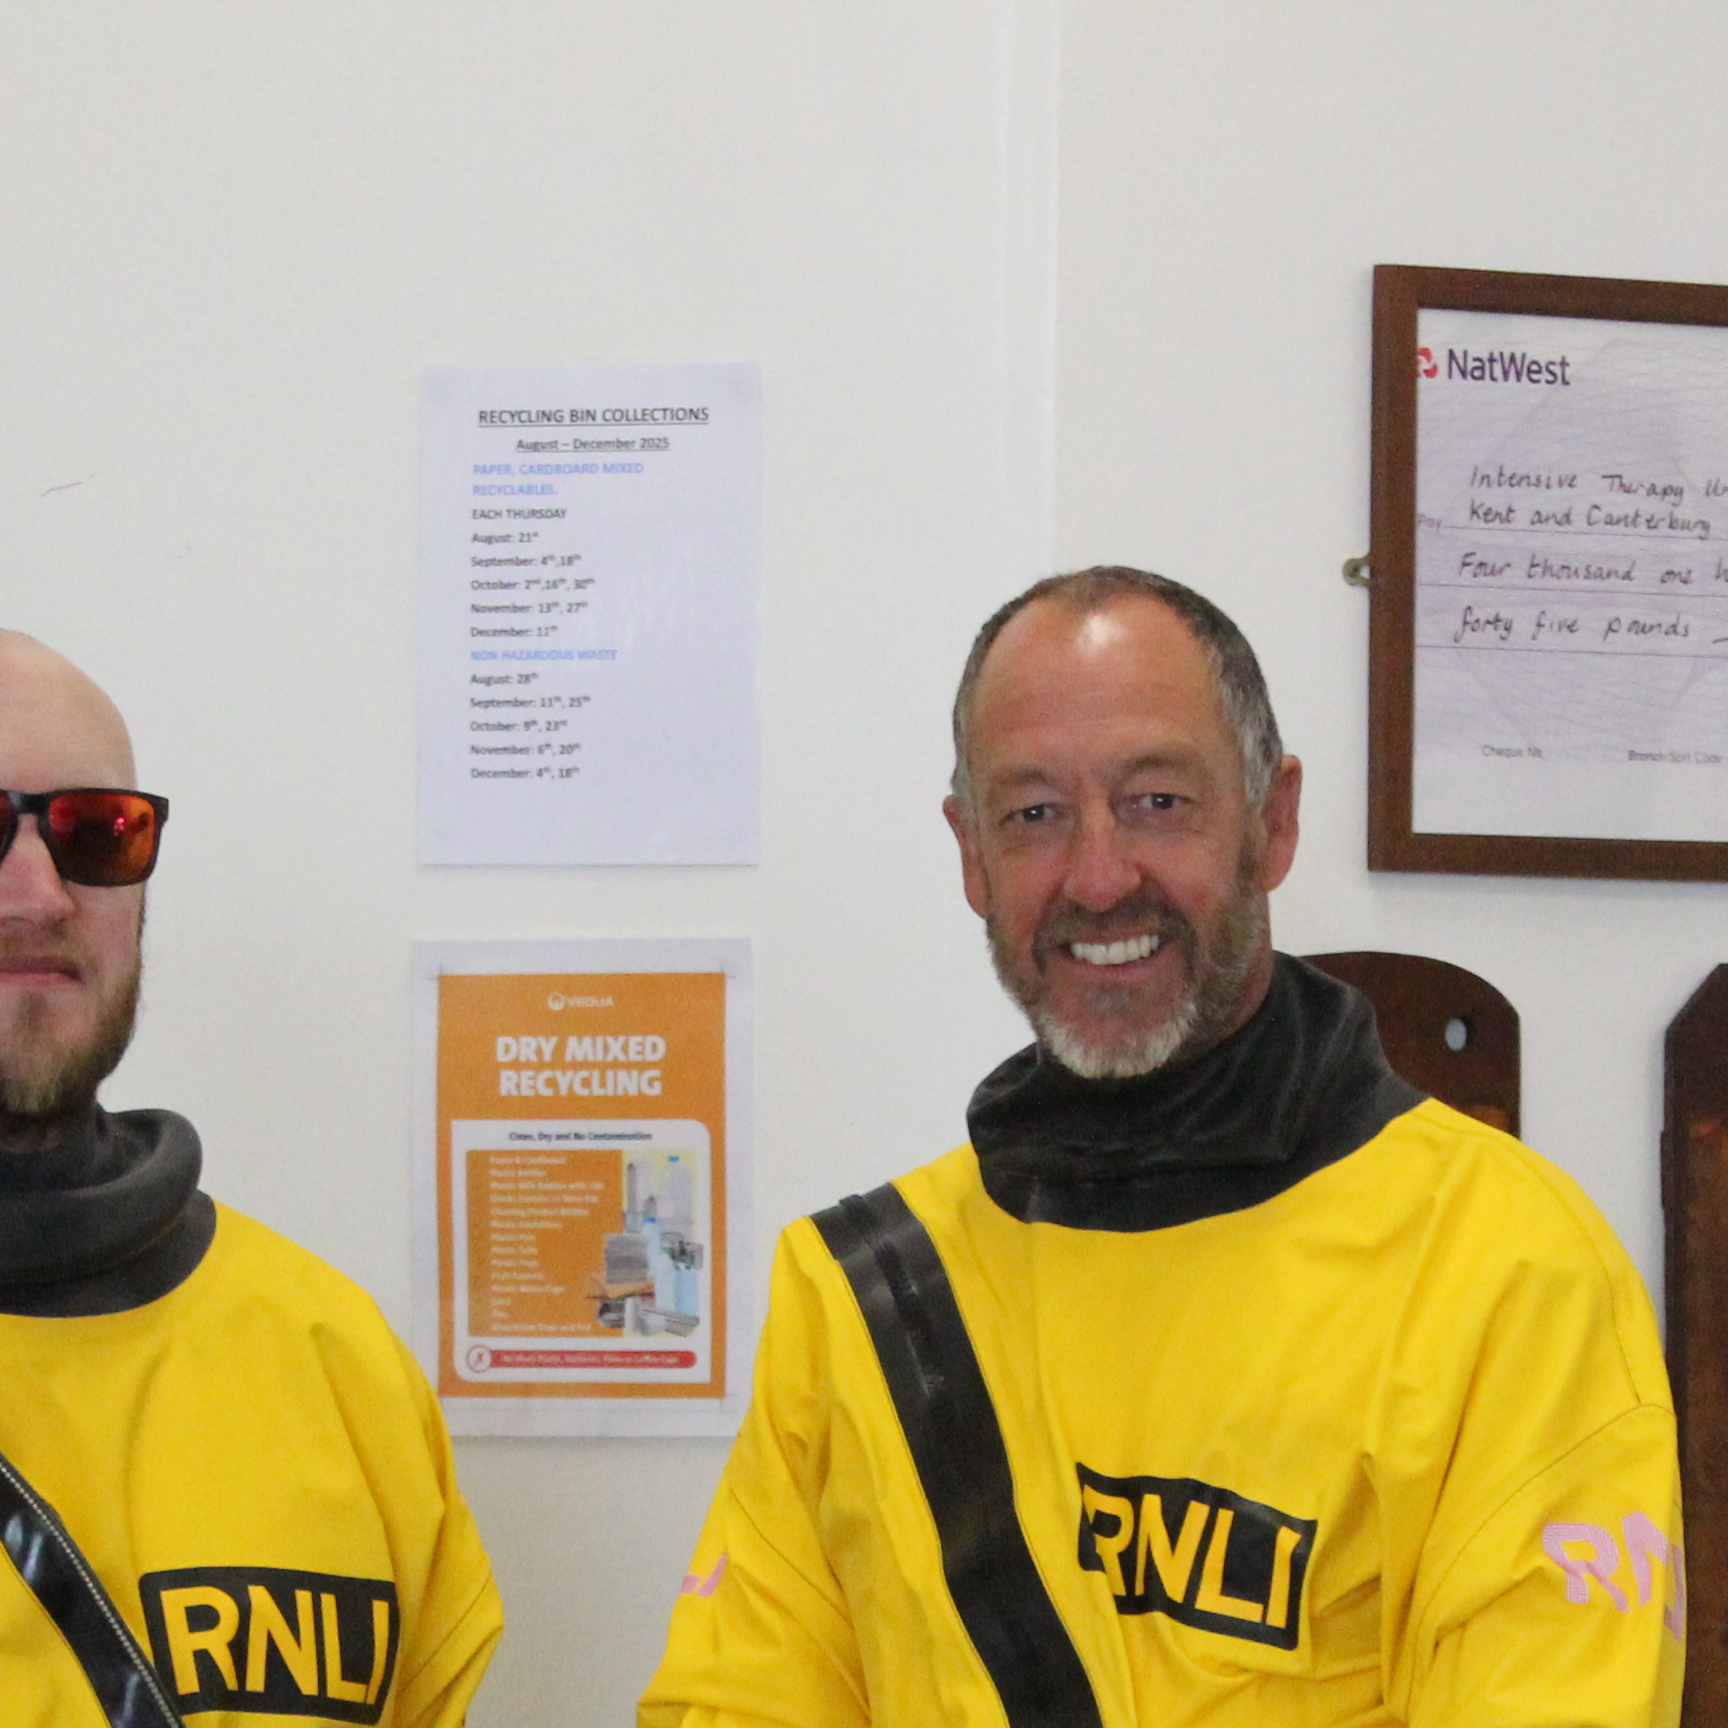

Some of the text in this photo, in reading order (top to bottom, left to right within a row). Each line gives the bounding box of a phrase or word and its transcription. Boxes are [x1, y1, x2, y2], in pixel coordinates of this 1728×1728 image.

[1448, 348, 1570, 386] NatWest
[478, 407, 710, 425] RECYCLING BIN COLLECTIONS
[516, 439, 559, 452] August
[573, 437, 636, 450] December
[640, 437, 670, 450] 2025
[519, 463, 599, 475] CARDBOARD
[602, 462, 645, 474] MIXED
[1471, 465, 1577, 489] Intensive
[1601, 474, 1684, 507] Therapy
[472, 508, 567, 519] EACH THURSDAY
[1470, 499, 1515, 524] Kent
[1530, 508, 1572, 526] and
[1587, 504, 1710, 540] Canterbury
[1459, 552, 1512, 577] Four
[1527, 553, 1636, 581] thousand
[1660, 568, 1693, 584] one
[1453, 605, 1690, 643] forty five pounds
[501, 649, 574, 660] HAZARDOUS
[496, 1034, 667, 1063] DRY MIXED
[499, 1068, 663, 1097] RECYCLING
[1083, 1485, 1302, 1630] RNLI
[160, 1584, 390, 1706] RNLI
